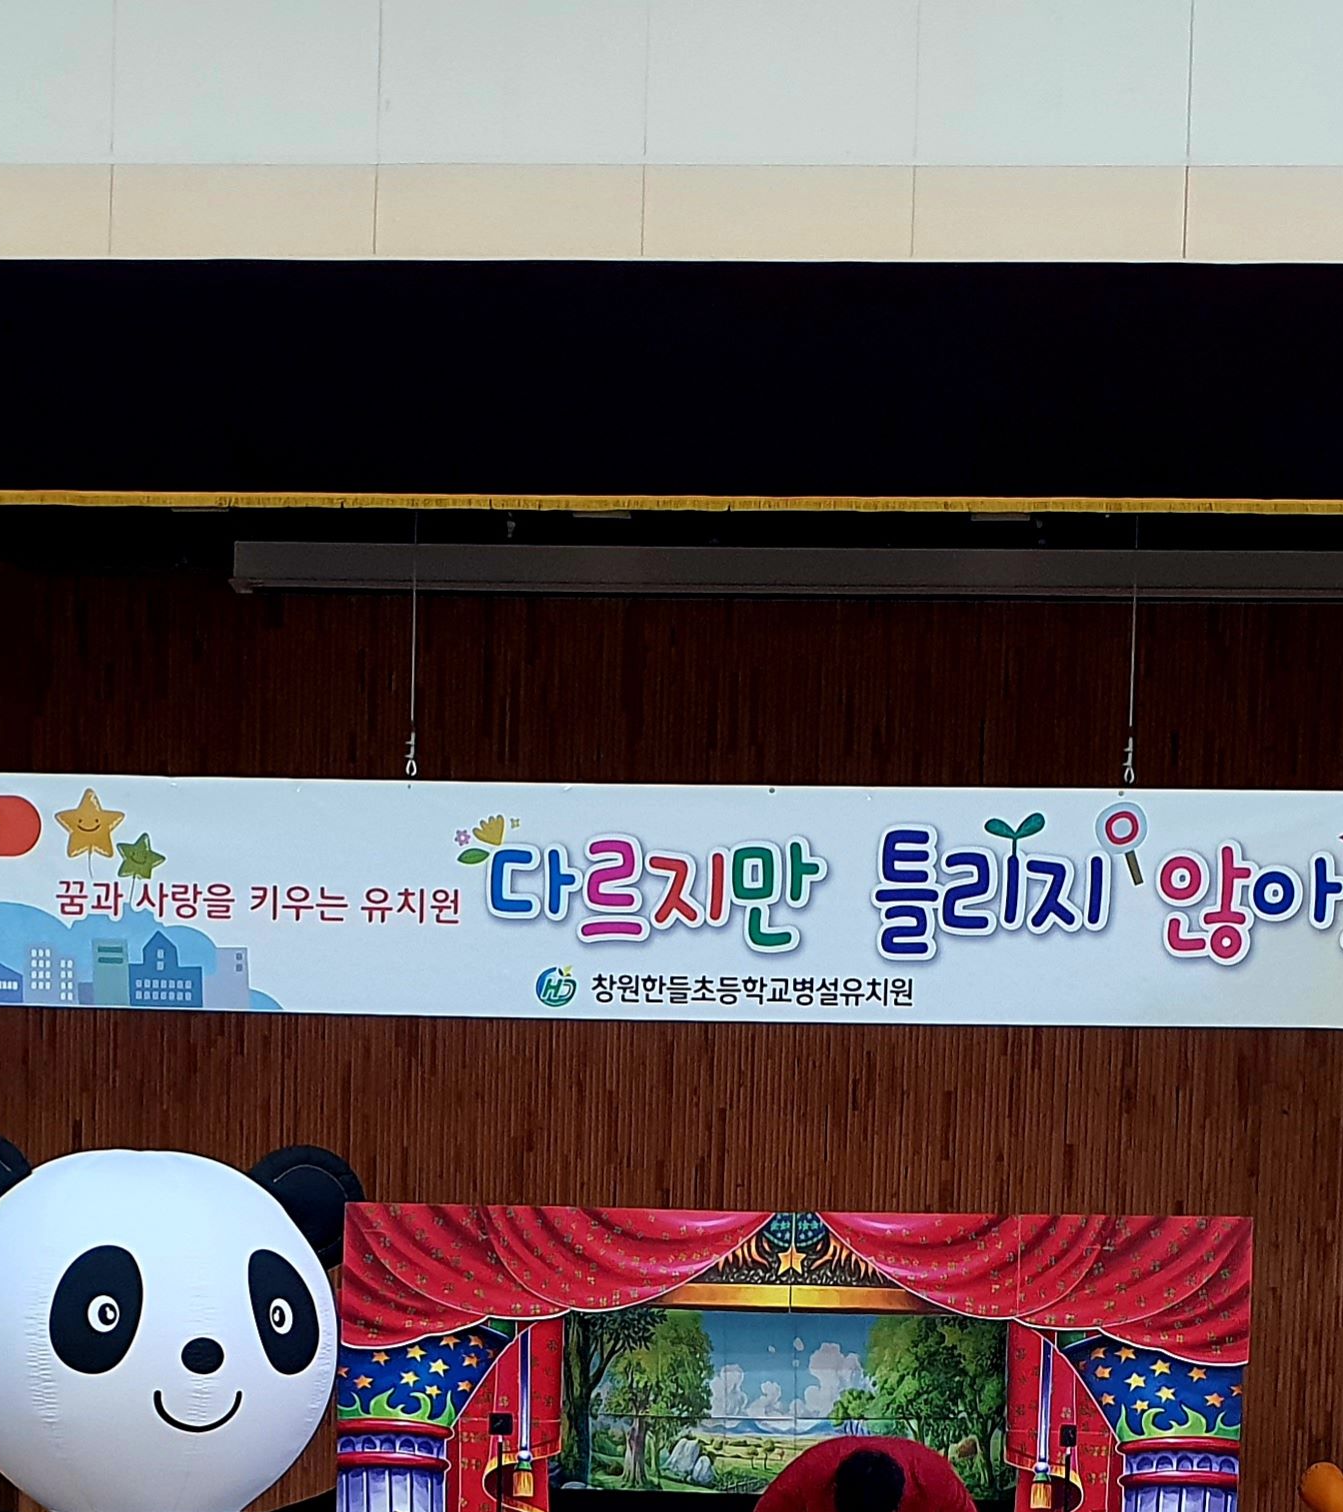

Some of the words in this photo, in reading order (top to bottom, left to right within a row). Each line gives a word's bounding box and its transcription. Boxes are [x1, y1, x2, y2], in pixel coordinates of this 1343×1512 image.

[55, 880, 124, 917] 꿈과
[135, 882, 236, 920] 사랑을
[250, 885, 350, 923] 키우는
[360, 887, 460, 925] 유치원
[487, 836, 824, 949] 다르지만
[873, 827, 1106, 957] 틀리지
[591, 973, 914, 1007] 창원한들초등학교병설유치원
